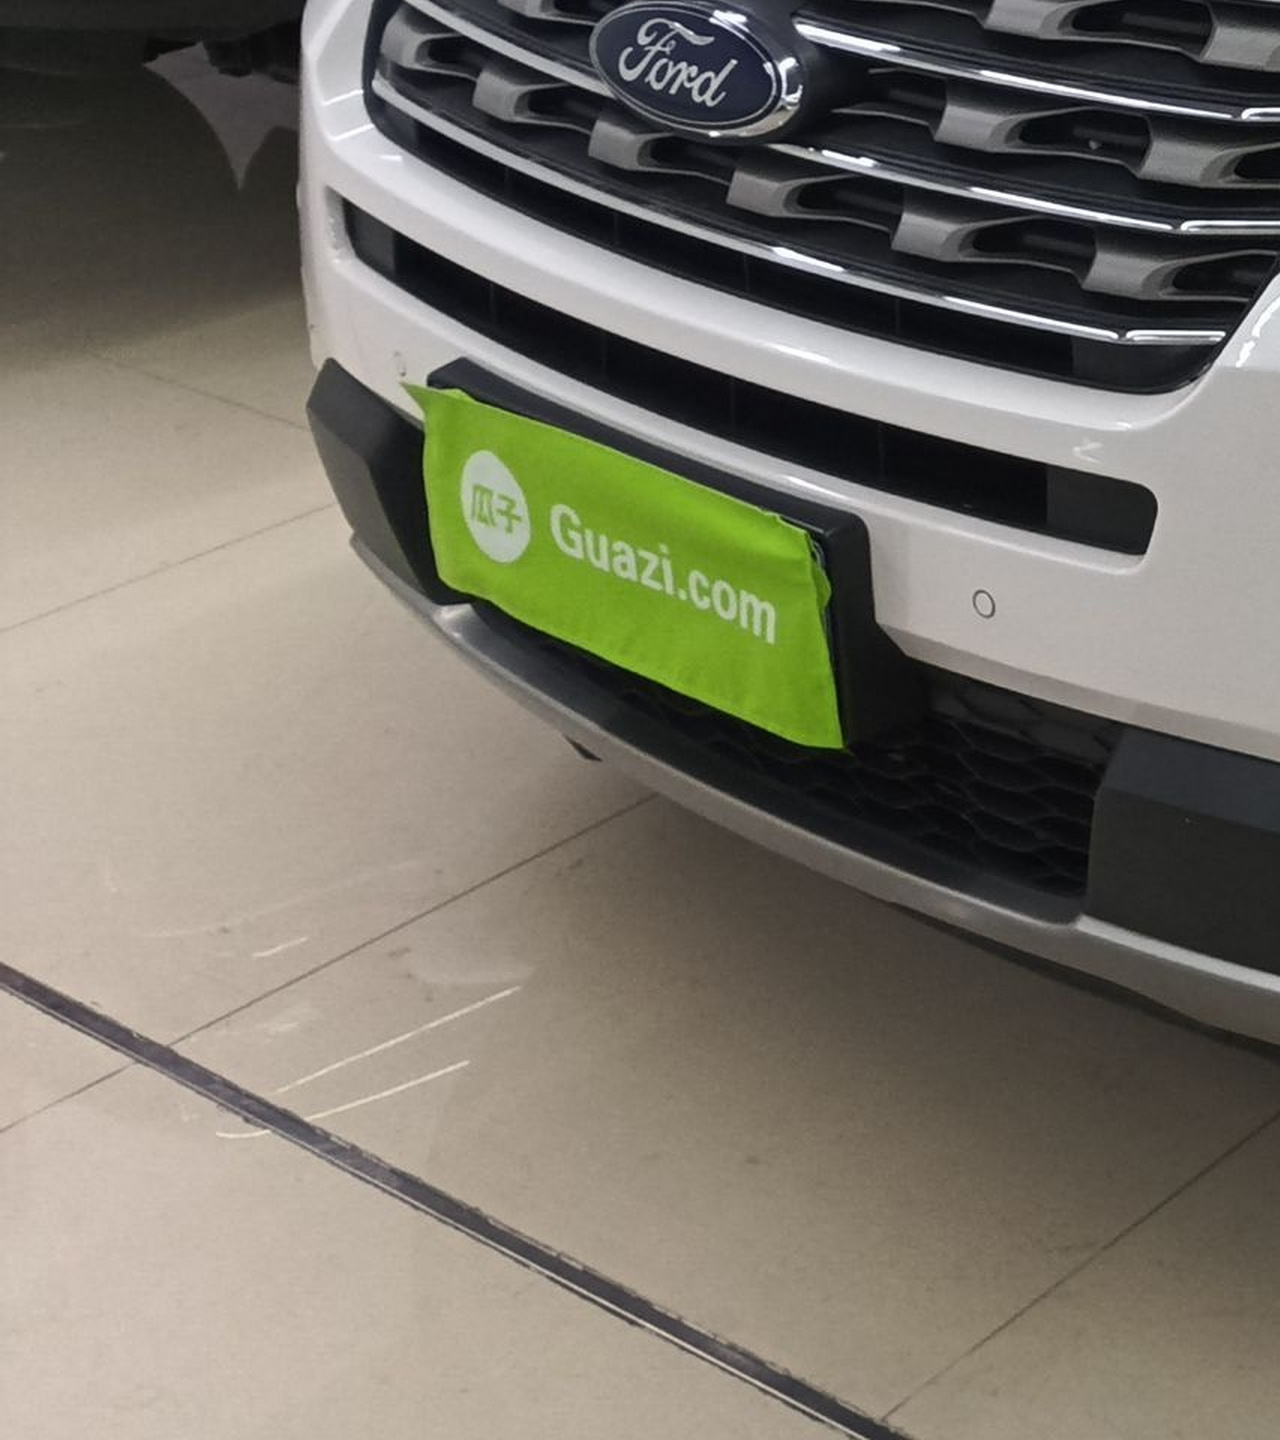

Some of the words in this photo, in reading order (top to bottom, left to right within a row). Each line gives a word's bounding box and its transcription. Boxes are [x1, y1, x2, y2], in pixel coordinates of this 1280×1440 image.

[618, 17, 738, 107] Ford
[470, 483, 523, 536] 瓜子
[549, 502, 777, 645] Guazi.com
